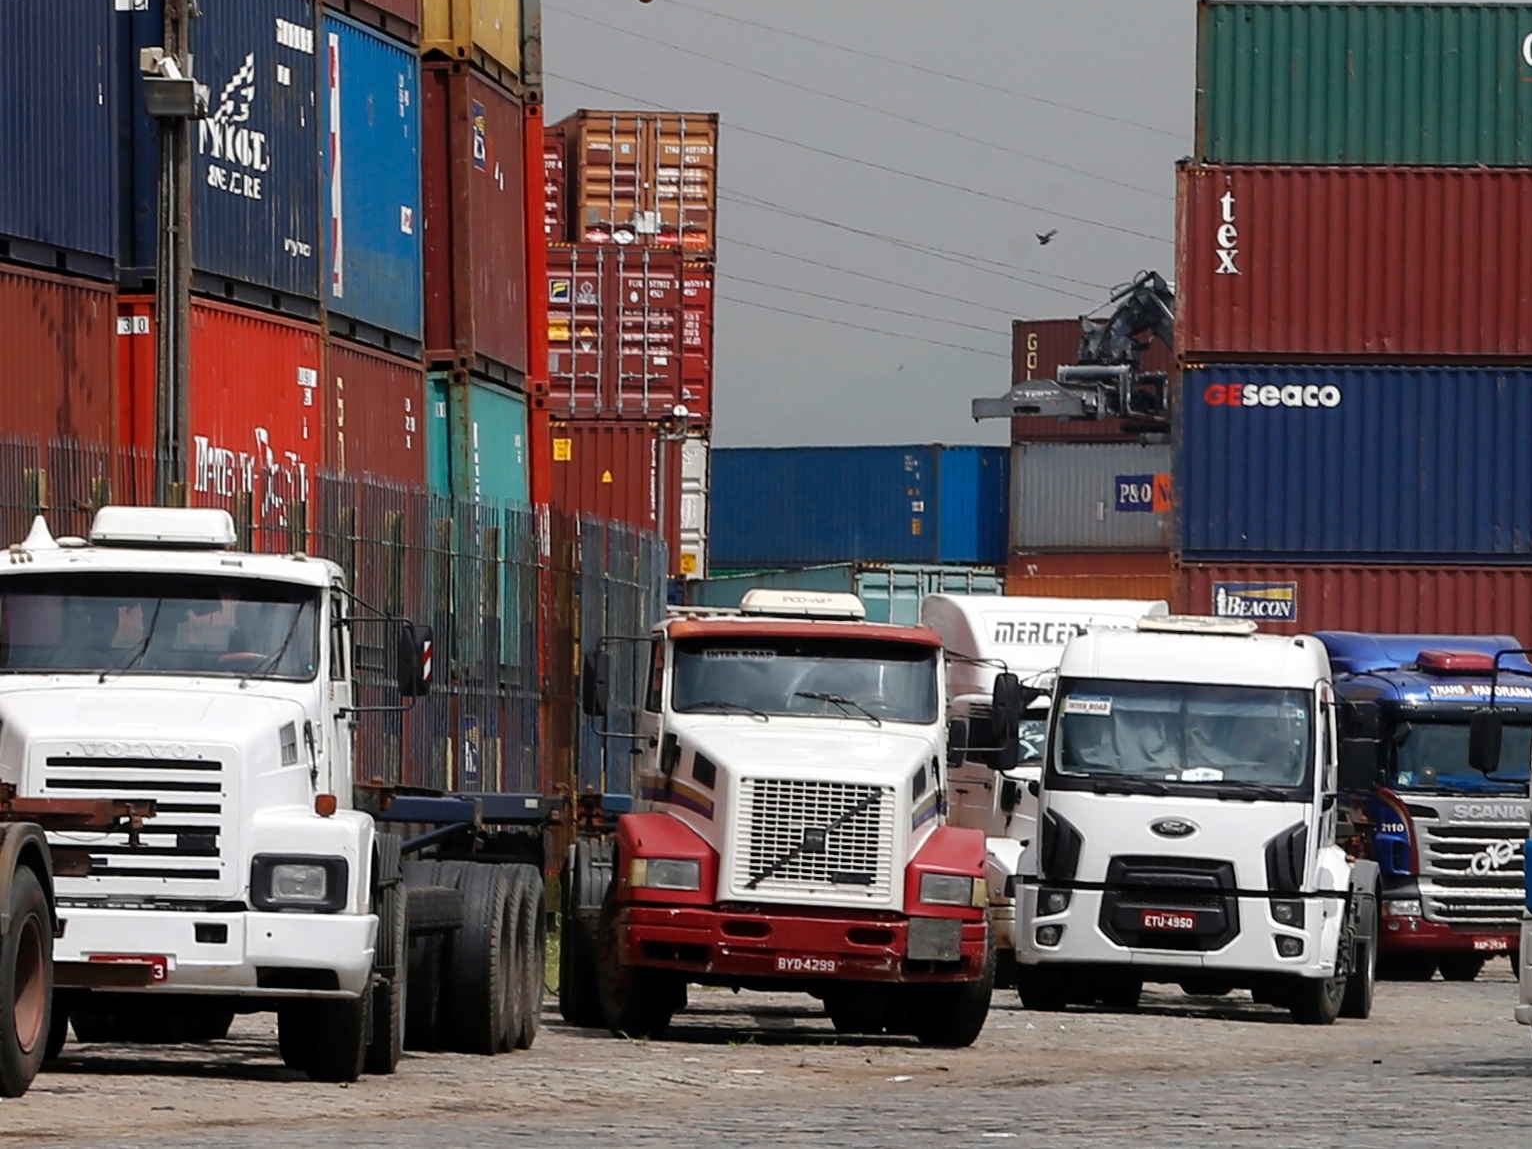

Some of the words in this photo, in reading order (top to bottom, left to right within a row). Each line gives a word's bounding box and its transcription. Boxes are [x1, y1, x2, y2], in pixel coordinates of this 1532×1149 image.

[1215, 190, 1240, 276] tex
[1204, 383, 1341, 409] GEseaco
[1120, 483, 1151, 503] P&O
[1227, 596, 1293, 617] BEACON
[1430, 685, 1466, 696] TRANS
[77, 742, 192, 759] VOLVO
[1453, 804, 1527, 819] SCANIA
[1381, 823, 1405, 833] 2110
[778, 957, 835, 971] BYD-4299
